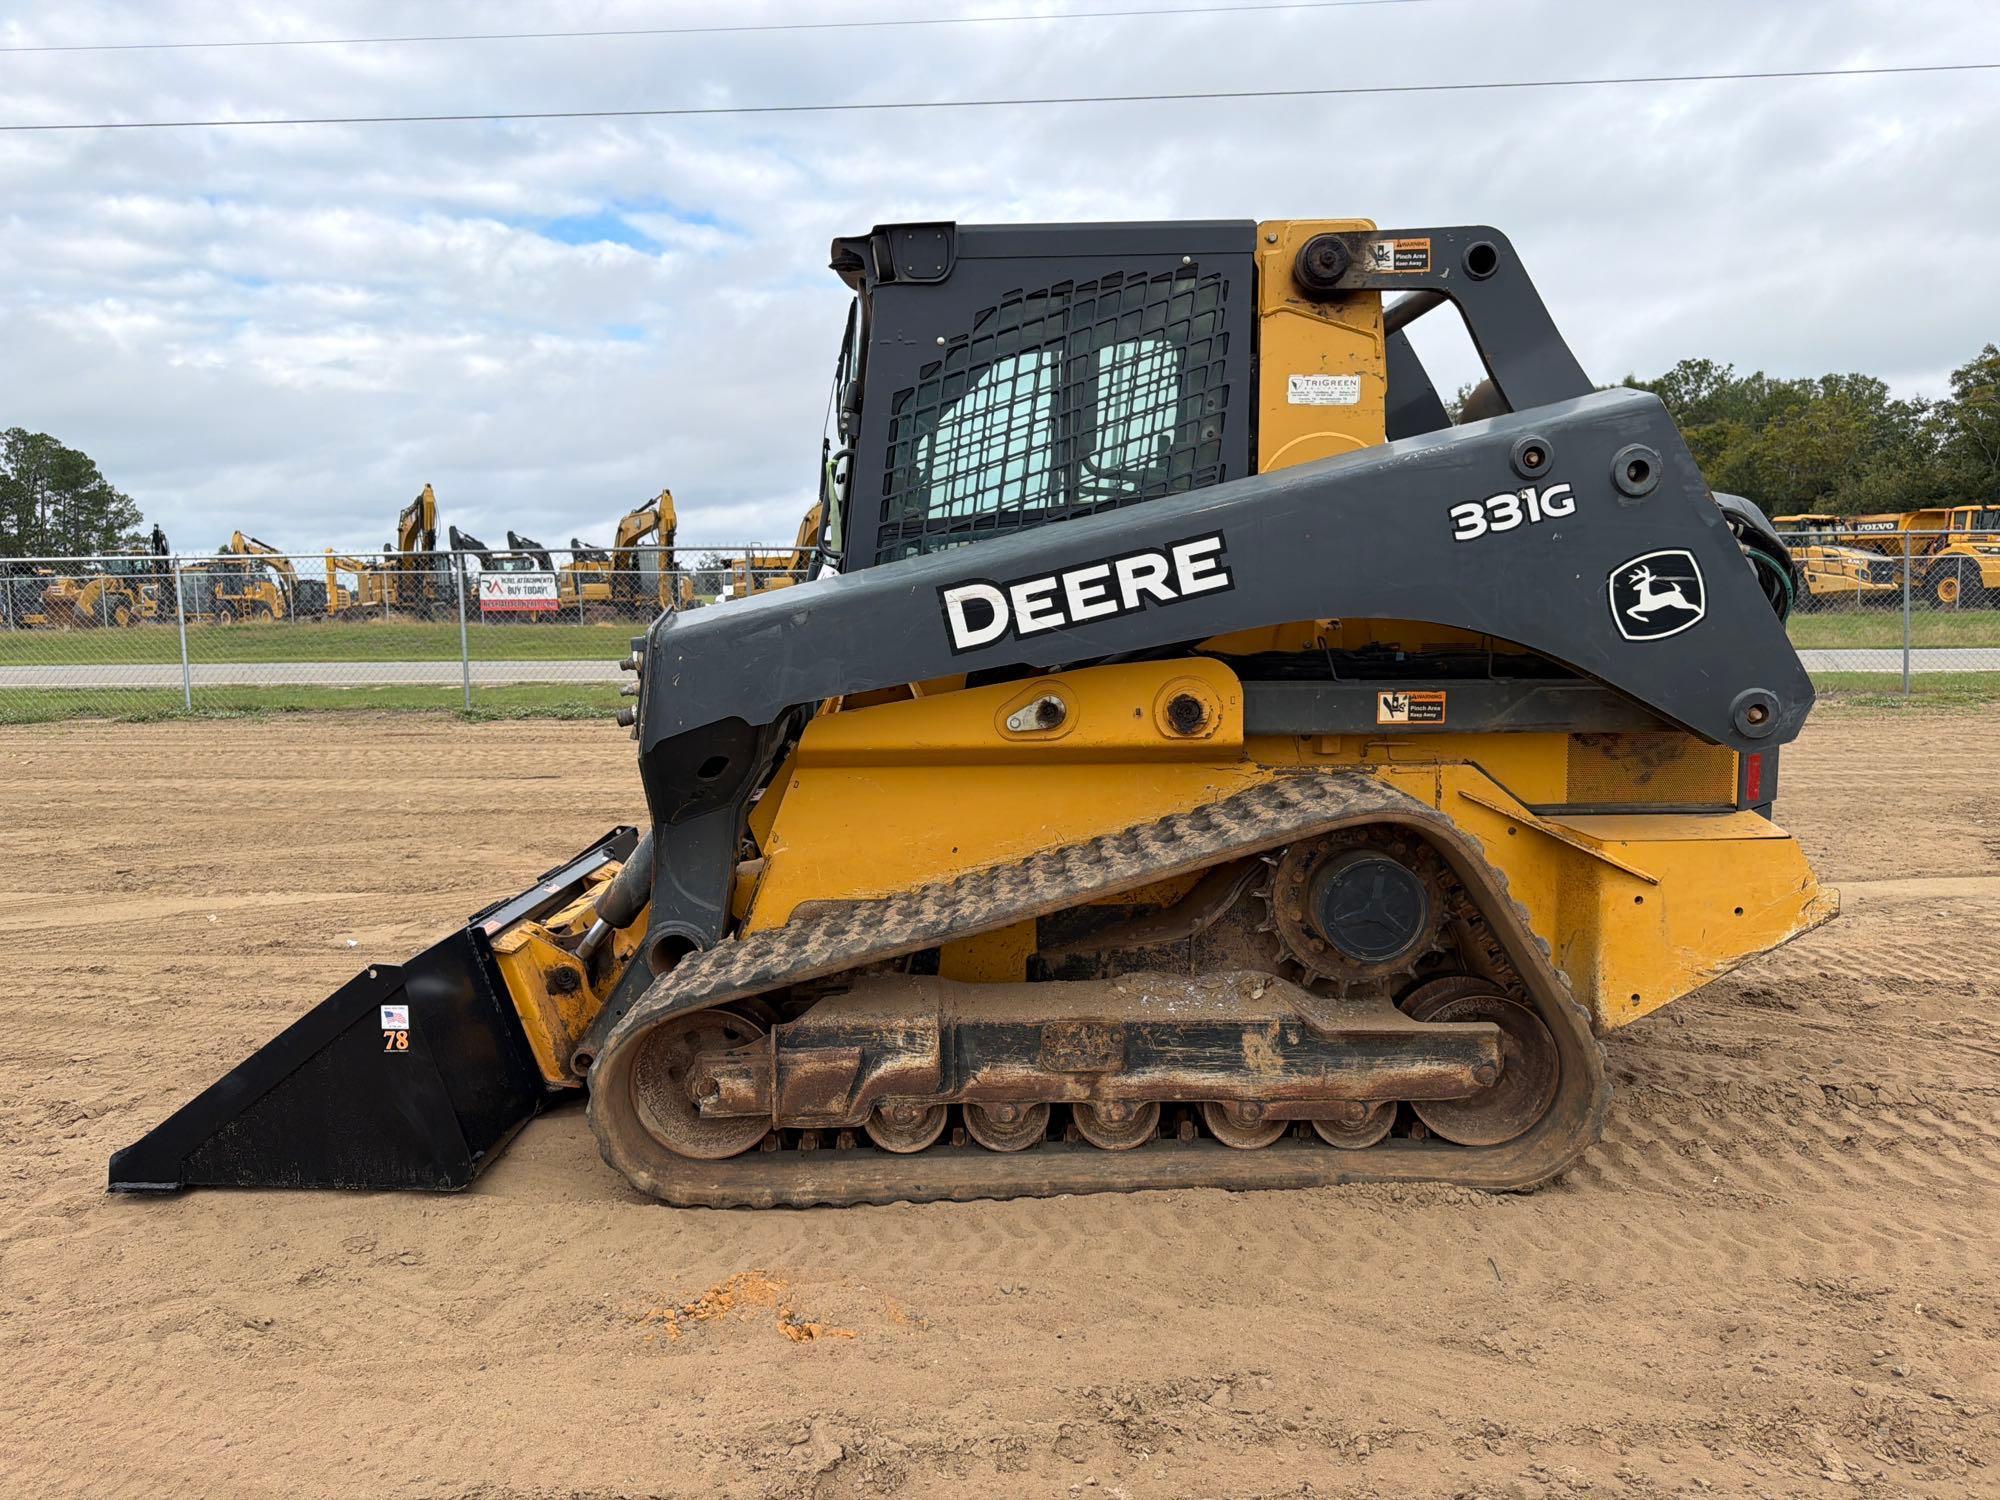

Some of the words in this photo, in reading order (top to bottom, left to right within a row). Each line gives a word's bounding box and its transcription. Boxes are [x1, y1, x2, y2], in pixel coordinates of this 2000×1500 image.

[1304, 379, 1357, 387] TRIGREEN
[1450, 483, 1576, 541] 331G
[1857, 522, 1894, 531] VOLVO
[507, 586, 521, 595] BUY
[943, 536, 1229, 650] DEERE
[383, 1030, 409, 1050] 78
